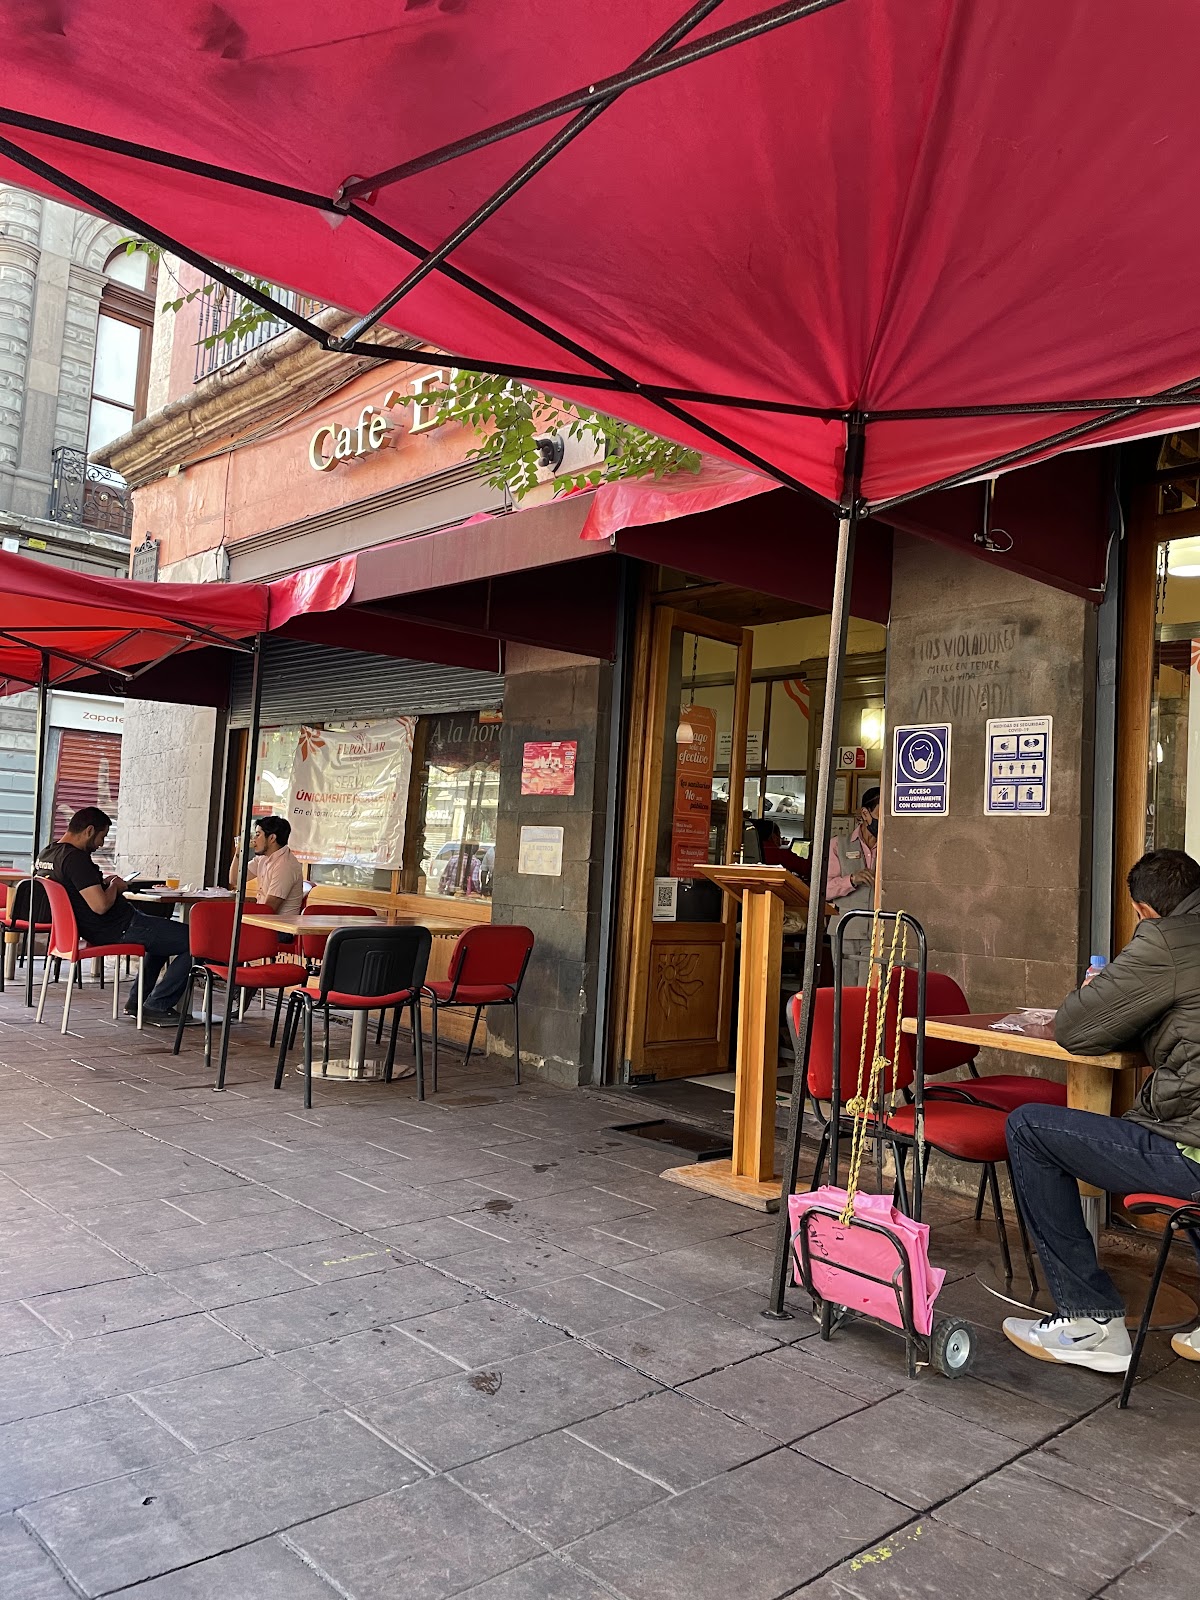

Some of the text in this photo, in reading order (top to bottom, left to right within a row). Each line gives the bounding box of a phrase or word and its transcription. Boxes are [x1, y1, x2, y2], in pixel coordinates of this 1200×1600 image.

[308, 390, 398, 473] Café
[943, 629, 1016, 659] VIOLADORES
[970, 660, 1000, 672] TENER
[430, 720, 442, 743] A
[447, 718, 464, 744] la
[679, 750, 709, 764] efectivo
[296, 789, 352, 804] ÚNICAMENTE
[908, 787, 932, 795] ACCESO
[293, 806, 303, 816] En
[305, 808, 313, 817] el
